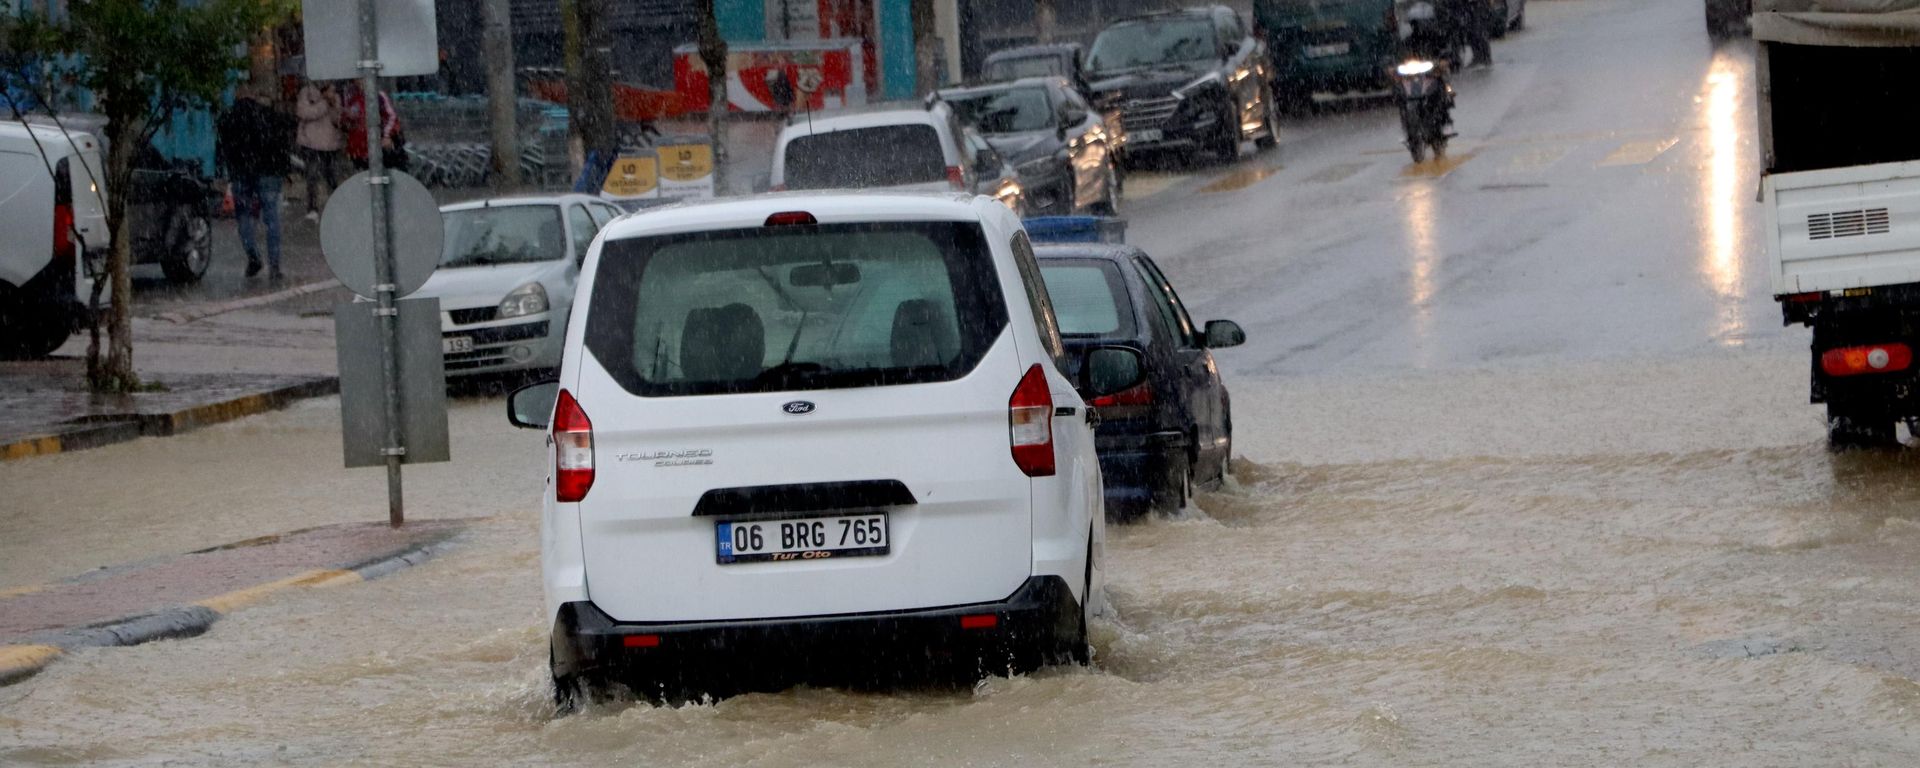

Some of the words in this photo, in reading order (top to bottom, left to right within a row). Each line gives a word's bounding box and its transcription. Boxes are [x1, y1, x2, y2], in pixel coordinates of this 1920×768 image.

[449, 338, 470, 351] 193
[616, 448, 713, 462] TOURNEO
[654, 459, 714, 468] COURIER
[734, 524, 764, 552] 06
[781, 520, 825, 550] BRG
[838, 518, 882, 547] 765
[720, 542, 732, 550] TR
[772, 551, 797, 561] Tur
[802, 550, 832, 560] Oto
